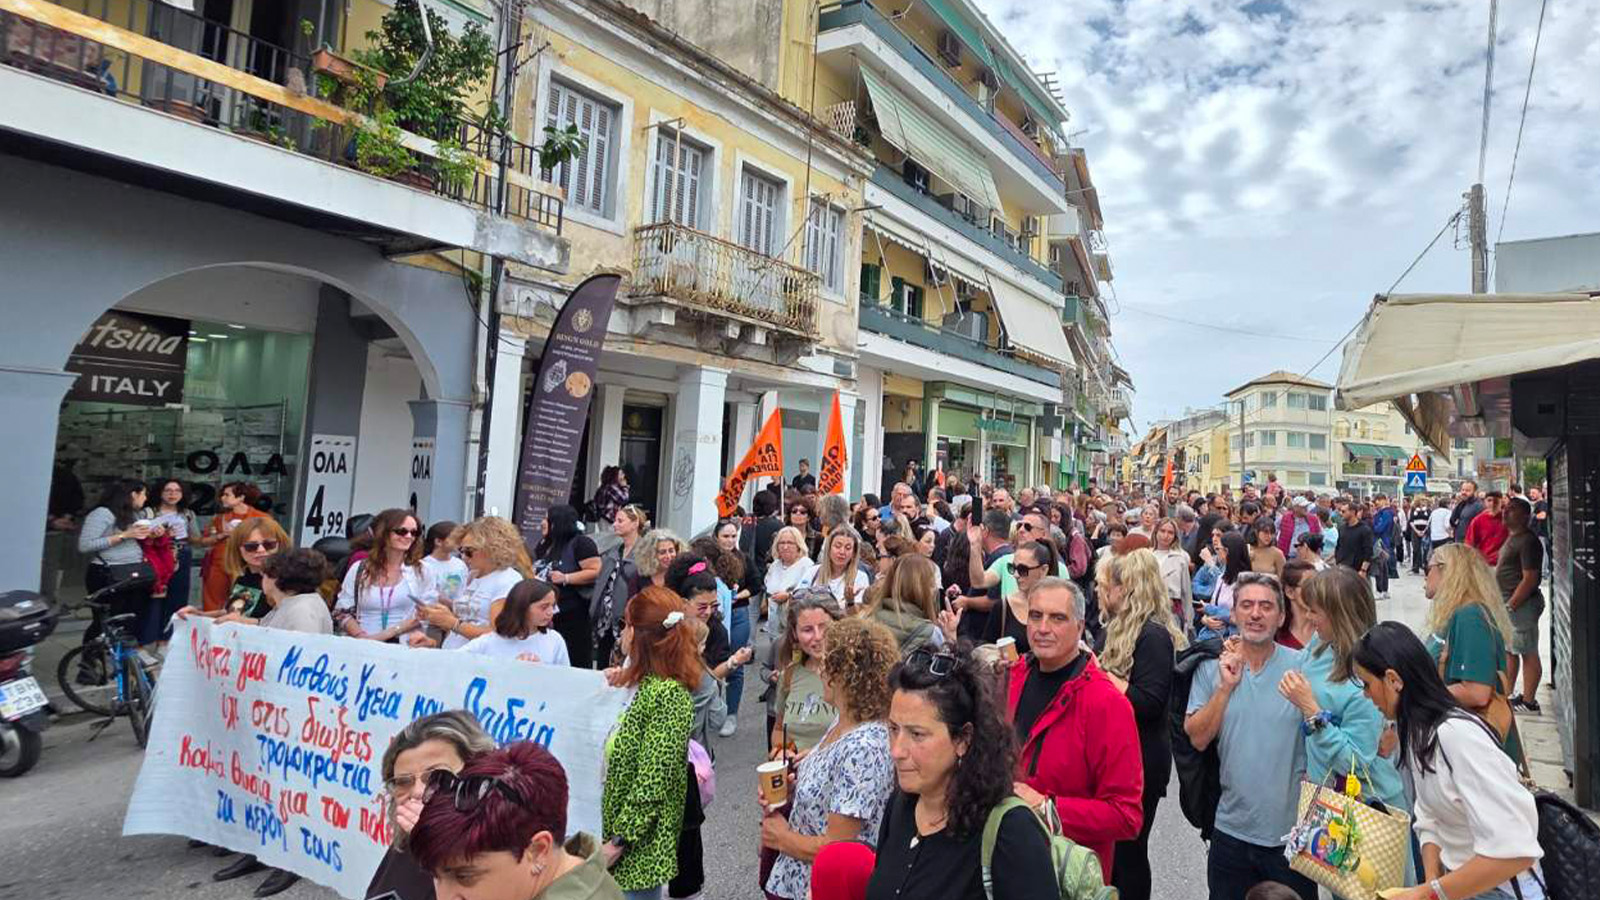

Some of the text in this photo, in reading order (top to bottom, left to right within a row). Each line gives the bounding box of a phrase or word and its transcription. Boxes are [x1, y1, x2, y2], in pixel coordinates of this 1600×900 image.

[90, 318, 183, 355] tsina
[91, 375, 171, 397] ITALY
[313, 451, 348, 474] ΟΛΑ
[412, 454, 431, 480] ΟΛΑ
[252, 700, 290, 738] στις
[279, 790, 309, 825] για
[320, 796, 351, 830] τον
[217, 790, 236, 824] τα
[300, 827, 344, 872] τους
